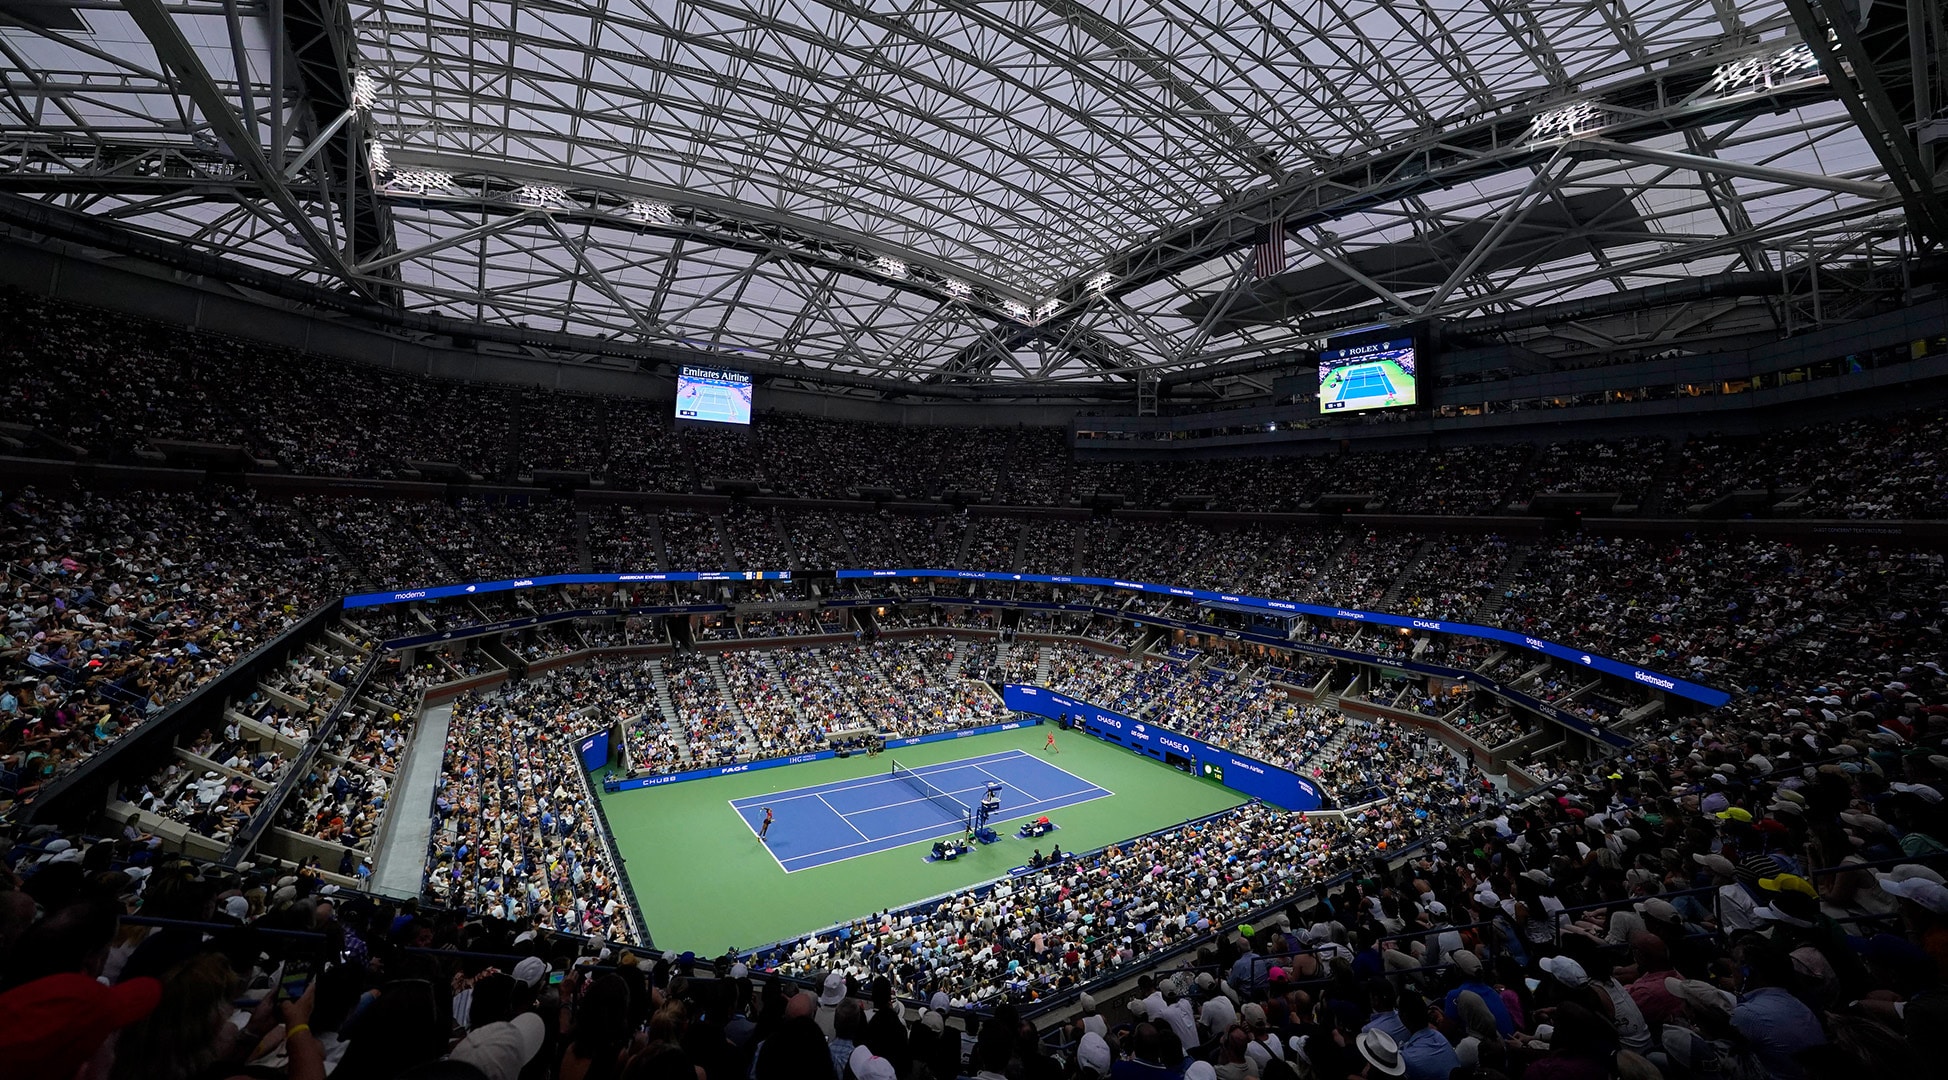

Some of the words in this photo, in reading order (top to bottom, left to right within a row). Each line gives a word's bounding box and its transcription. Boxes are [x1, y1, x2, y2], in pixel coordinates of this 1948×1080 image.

[1350, 345, 1378, 355] ROLEX
[395, 592, 425, 600] moderna
[1413, 620, 1440, 630] CHASE
[1526, 637, 1544, 648] DOBEL
[1635, 670, 1674, 690] ticketmaster
[1540, 705, 1557, 718] CHASE
[1096, 714, 1116, 726] CHASE
[1137, 732, 1149, 740] open
[1160, 736, 1182, 750] CHASE
[722, 765, 748, 774] FAGE
[642, 776, 676, 786] CHUBB
